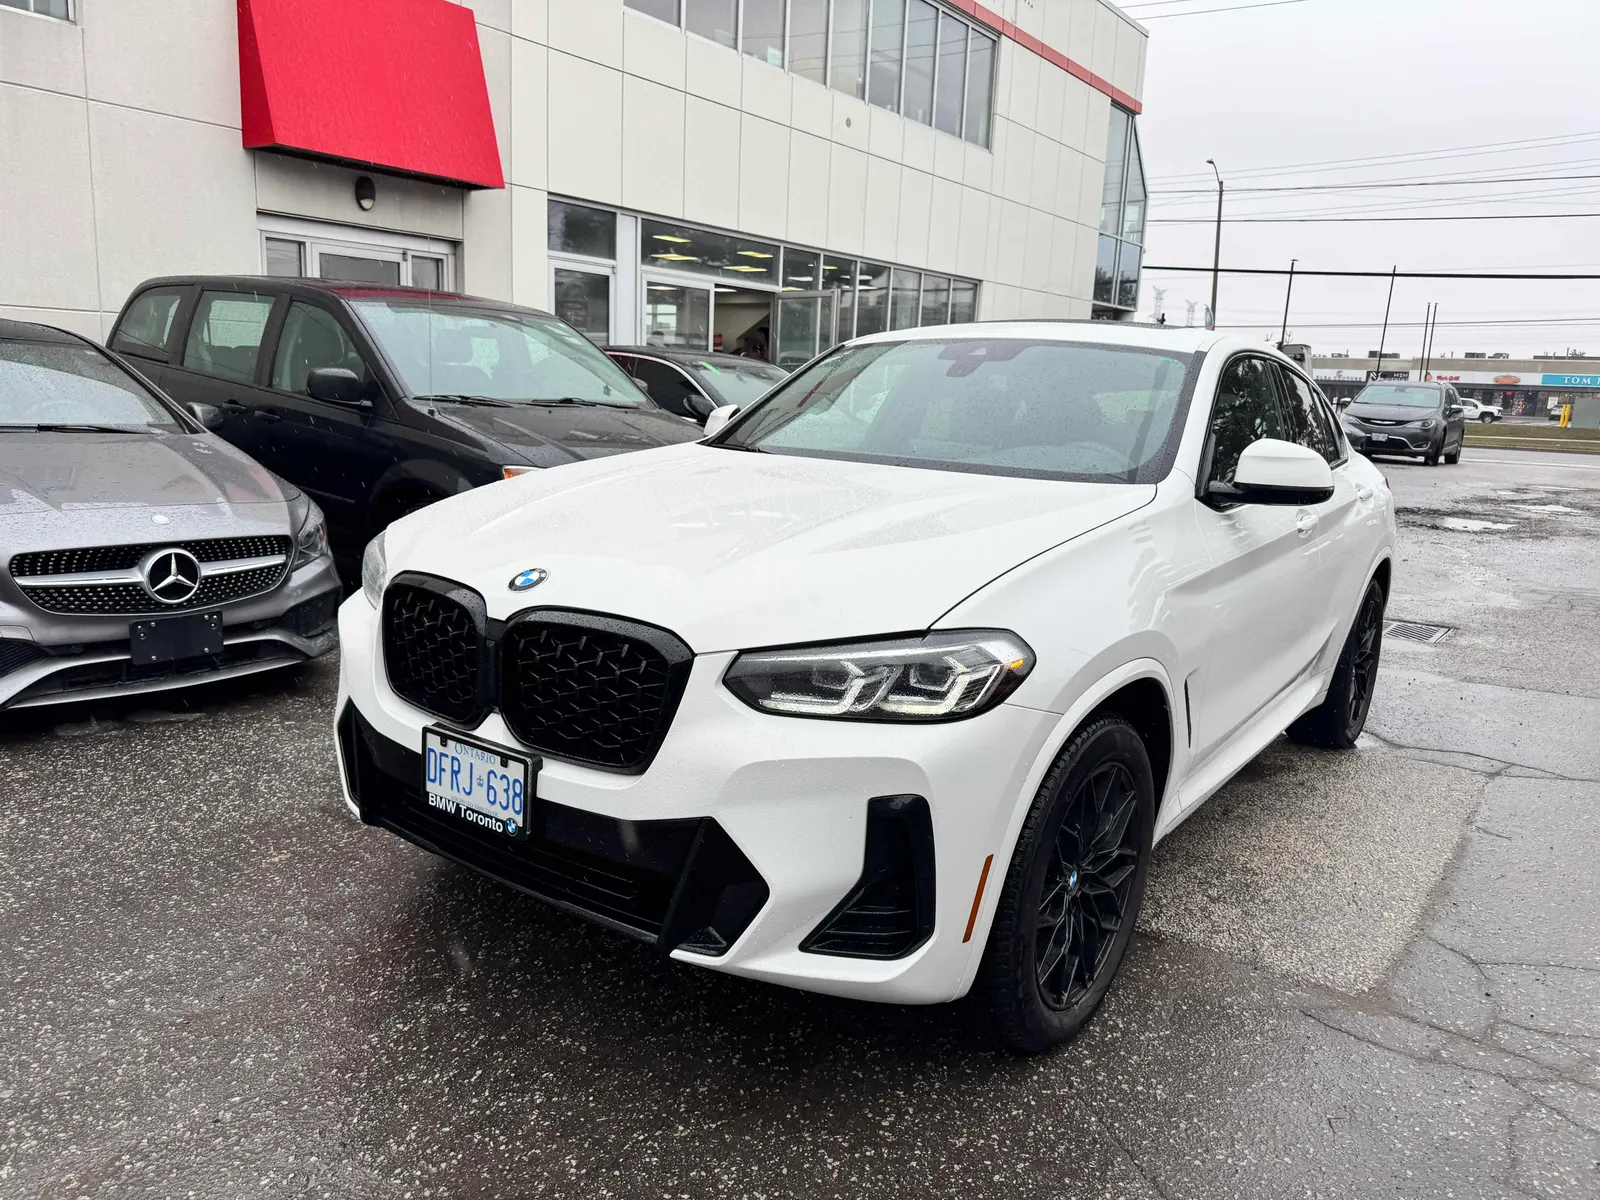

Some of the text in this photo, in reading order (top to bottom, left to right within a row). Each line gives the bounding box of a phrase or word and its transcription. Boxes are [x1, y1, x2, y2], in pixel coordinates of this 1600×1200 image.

[1563, 376, 1591, 385] TOM
[455, 742, 496, 765] ONTARIO
[427, 747, 523, 815] DFRJ 638
[428, 794, 504, 833] BMW Toronto
